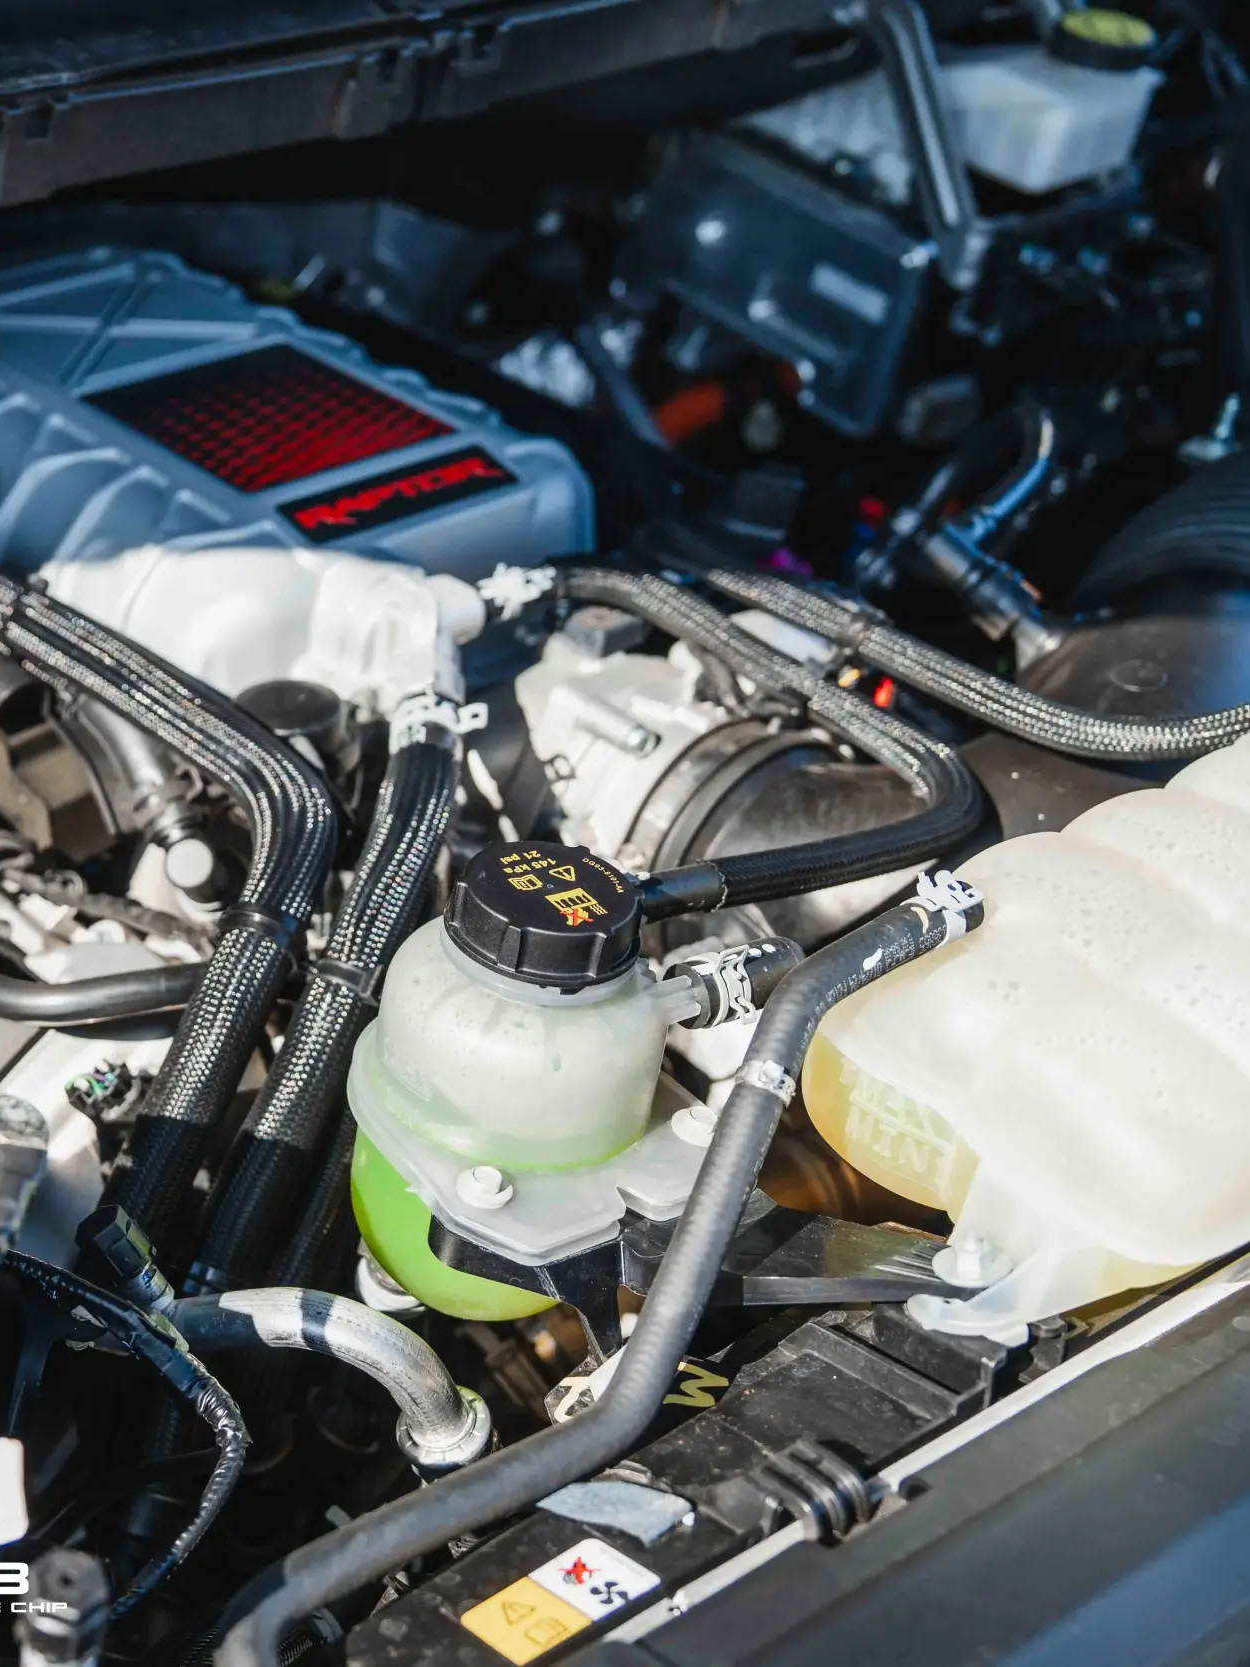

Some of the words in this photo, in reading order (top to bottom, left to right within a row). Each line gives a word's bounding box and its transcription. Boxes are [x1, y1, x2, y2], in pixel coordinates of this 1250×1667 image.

[294, 457, 504, 528] RAPTOR
[500, 853, 520, 865] psi
[523, 850, 541, 860] 21
[503, 862, 531, 874] kPa
[531, 857, 557, 869] 145
